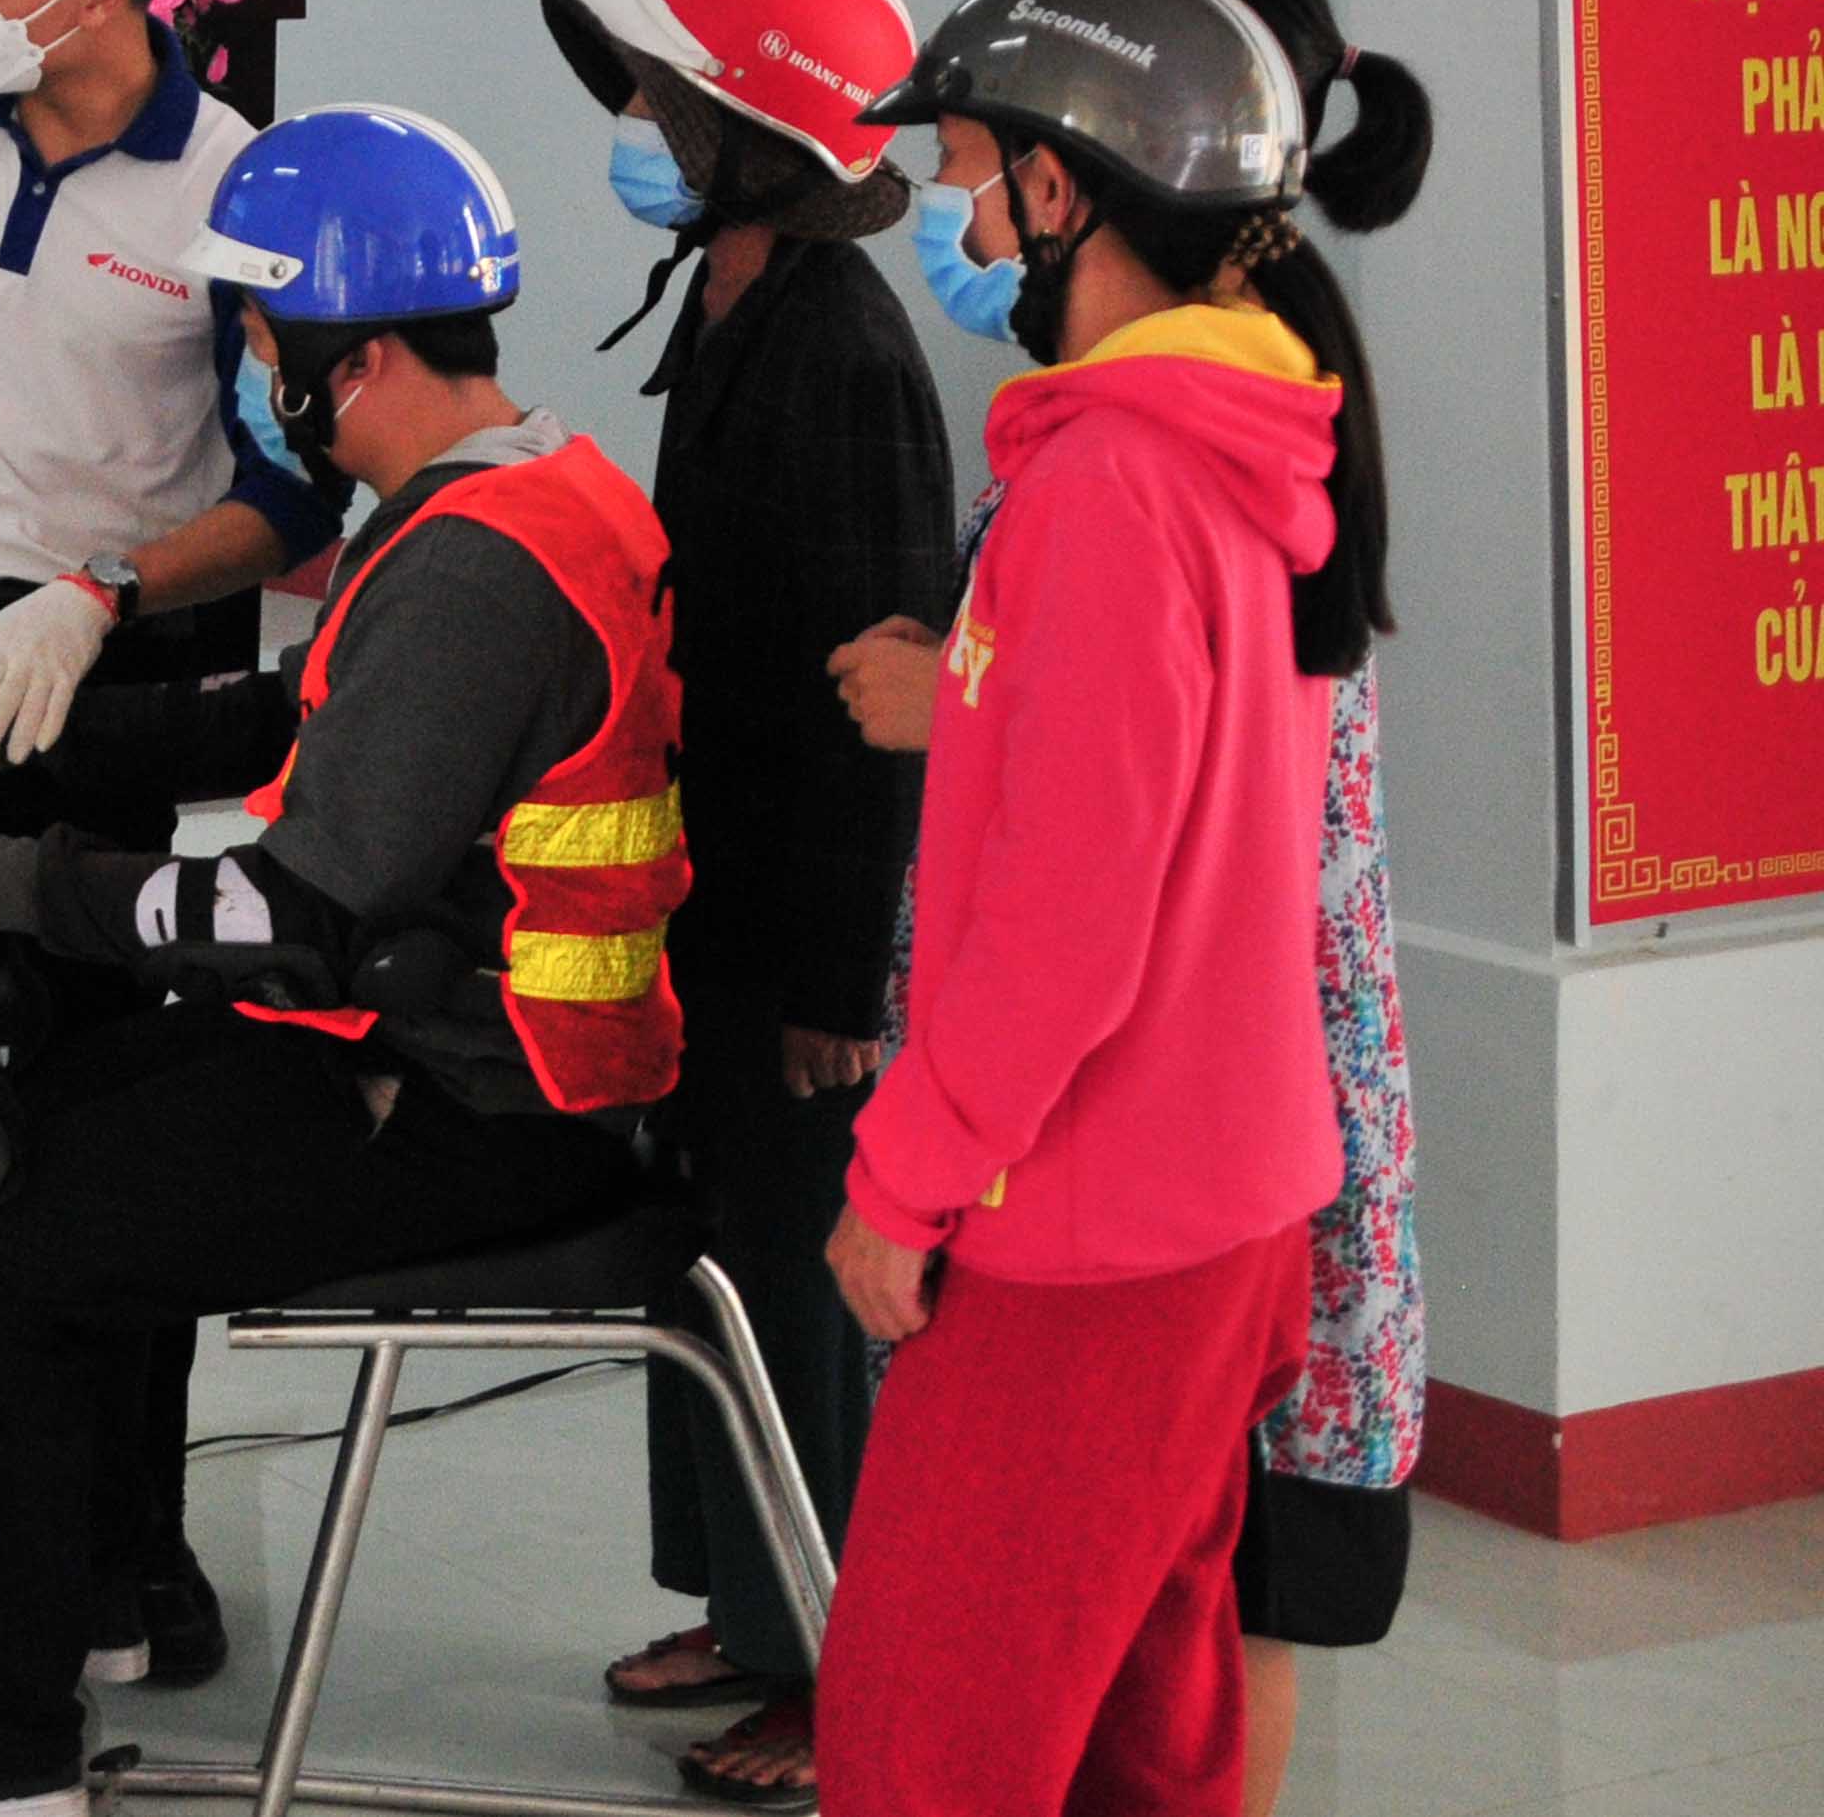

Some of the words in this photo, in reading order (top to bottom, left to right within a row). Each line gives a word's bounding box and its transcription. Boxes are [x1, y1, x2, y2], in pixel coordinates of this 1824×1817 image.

[788, 50, 843, 90] HOÀNG
[1709, 180, 1763, 276] LÀ
[109, 261, 190, 301] HONDA
[1750, 315, 1806, 411] LÀ
